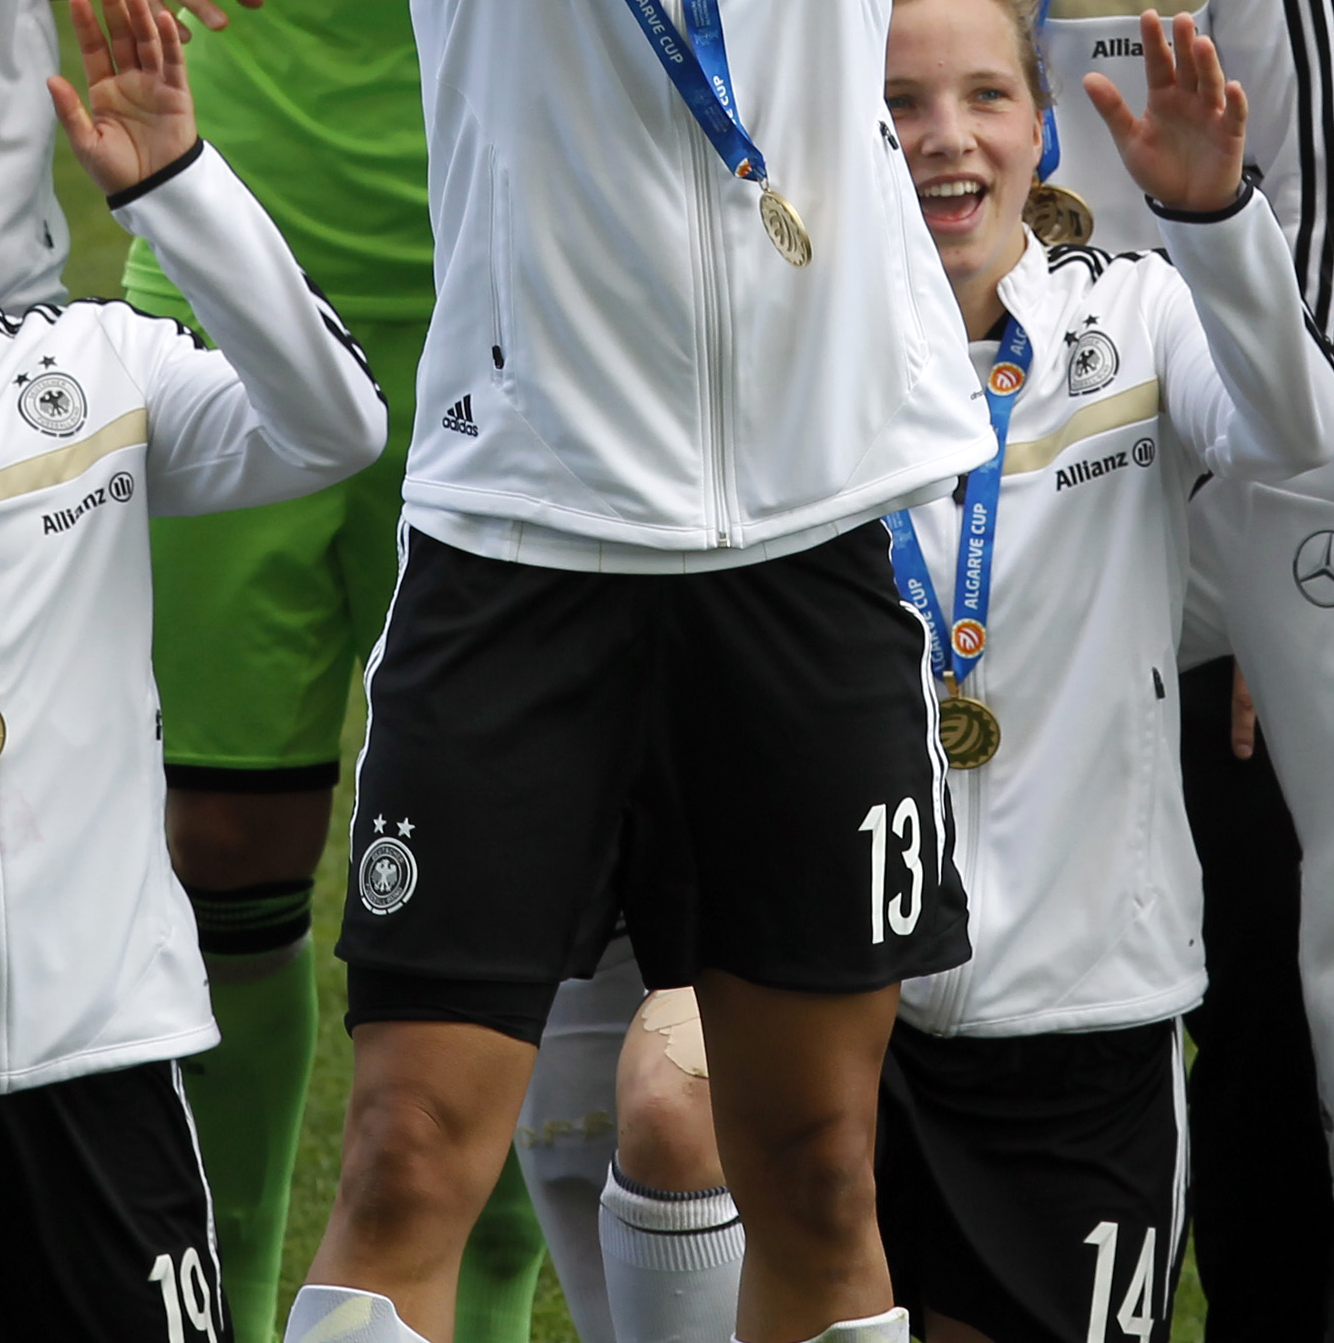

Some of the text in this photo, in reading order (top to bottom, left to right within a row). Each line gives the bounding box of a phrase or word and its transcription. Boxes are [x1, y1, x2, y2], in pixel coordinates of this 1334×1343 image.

[660, 34, 684, 65] CUP
[1092, 38, 1145, 59] Allia
[442, 414, 479, 437] adidas
[1055, 451, 1129, 491] Allianz
[41, 488, 107, 535] Allianz
[965, 502, 988, 610] ALGARVE CUP
[858, 797, 924, 945] 13
[1084, 1221, 1155, 1343] 14
